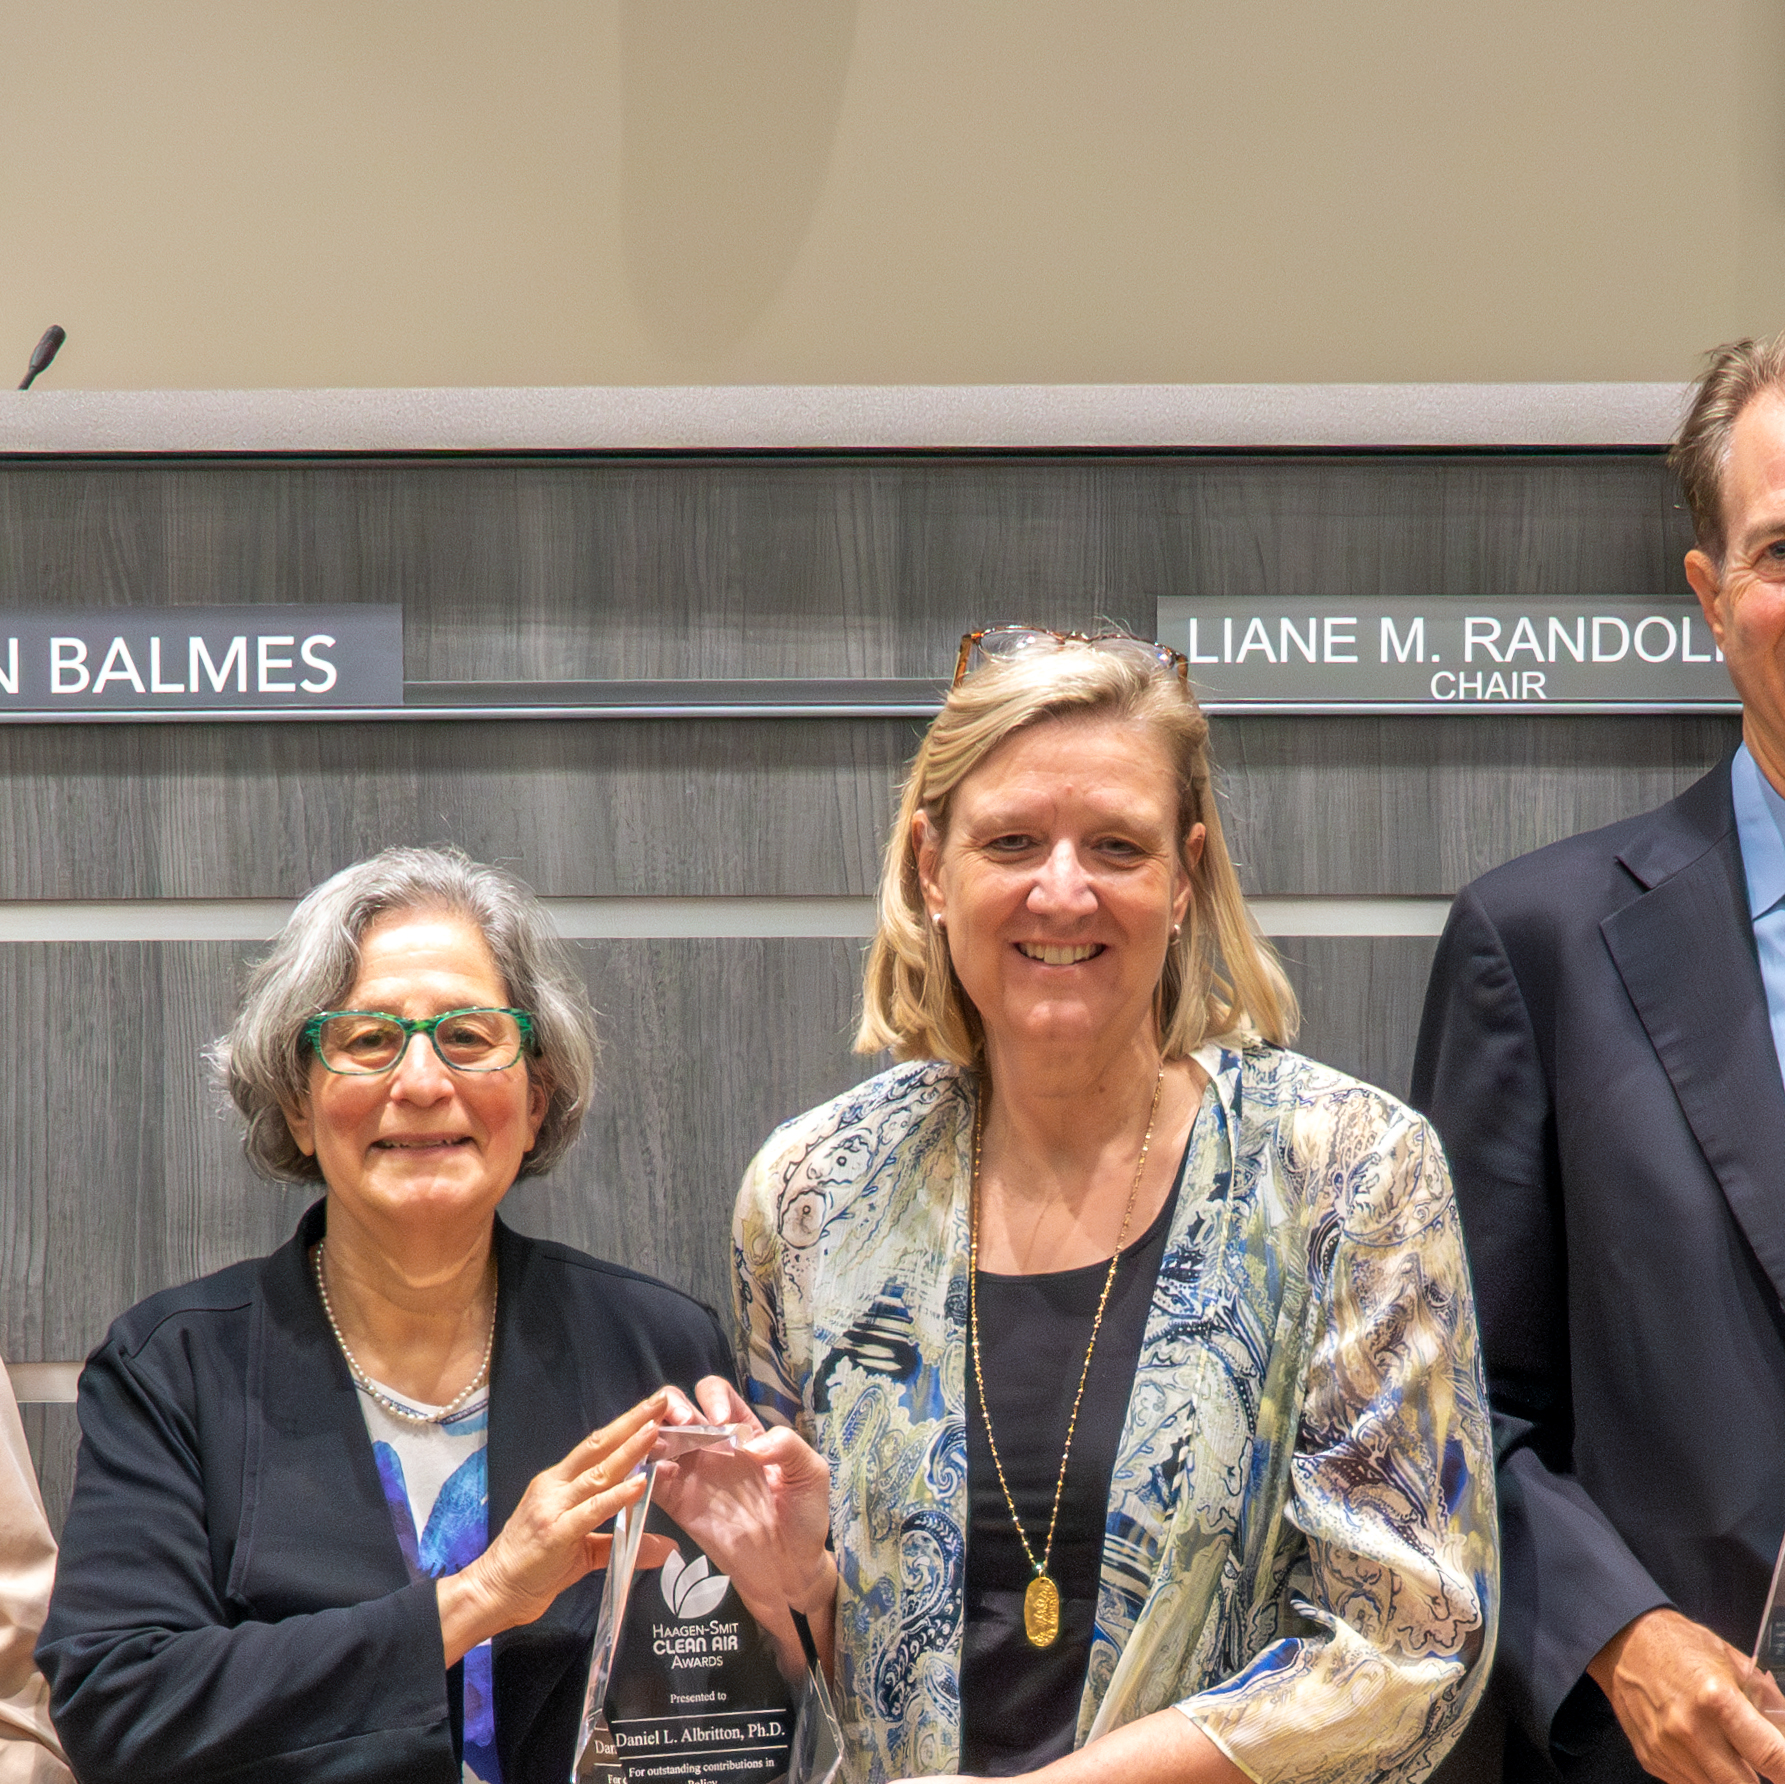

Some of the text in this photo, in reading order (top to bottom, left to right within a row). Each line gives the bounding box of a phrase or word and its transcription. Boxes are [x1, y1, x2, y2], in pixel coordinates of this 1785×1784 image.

[1189, 615, 1724, 663] LIANE M. RANDOL
[50, 634, 338, 694] BALMES
[1430, 670, 1546, 700] CHAIR
[712, 1635, 738, 1651] AIR
[670, 1691, 727, 1703] Presented to
[616, 1722, 785, 1747] Daniel L. Albritton, Ph.D.
[629, 1757, 774, 1777] For outstanding contributions in
